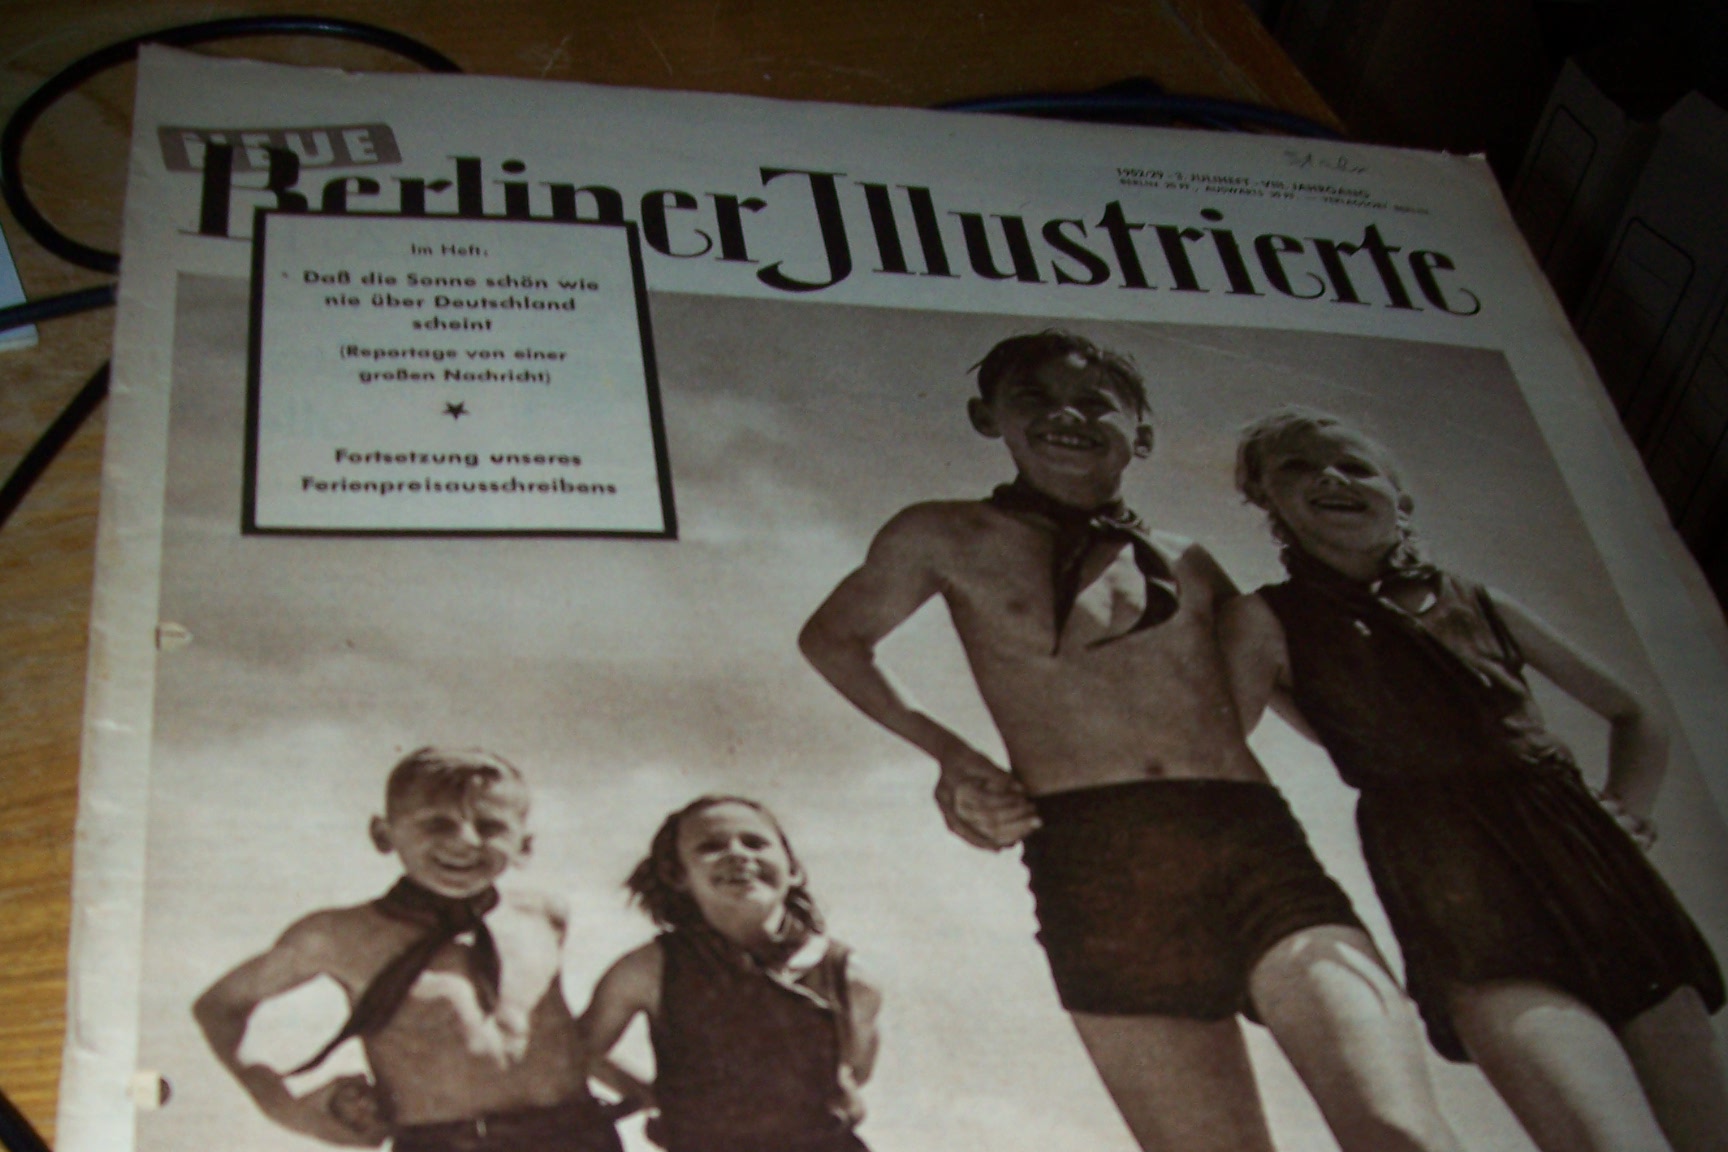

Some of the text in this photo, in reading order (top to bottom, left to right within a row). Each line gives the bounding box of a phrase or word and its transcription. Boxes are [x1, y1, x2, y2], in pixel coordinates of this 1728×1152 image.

[441, 243, 489, 257] Heft:
[303, 270, 600, 292] Daß die Sonne schön wie
[325, 293, 576, 311] nie über Deutschland
[412, 316, 493, 331] scheint
[340, 344, 568, 362] (Reportage von einer
[358, 368, 552, 385] großen Nachricht)
[334, 447, 583, 468] Fortsetzung unseres
[301, 475, 618, 496] Ferienpreisausschreibens
